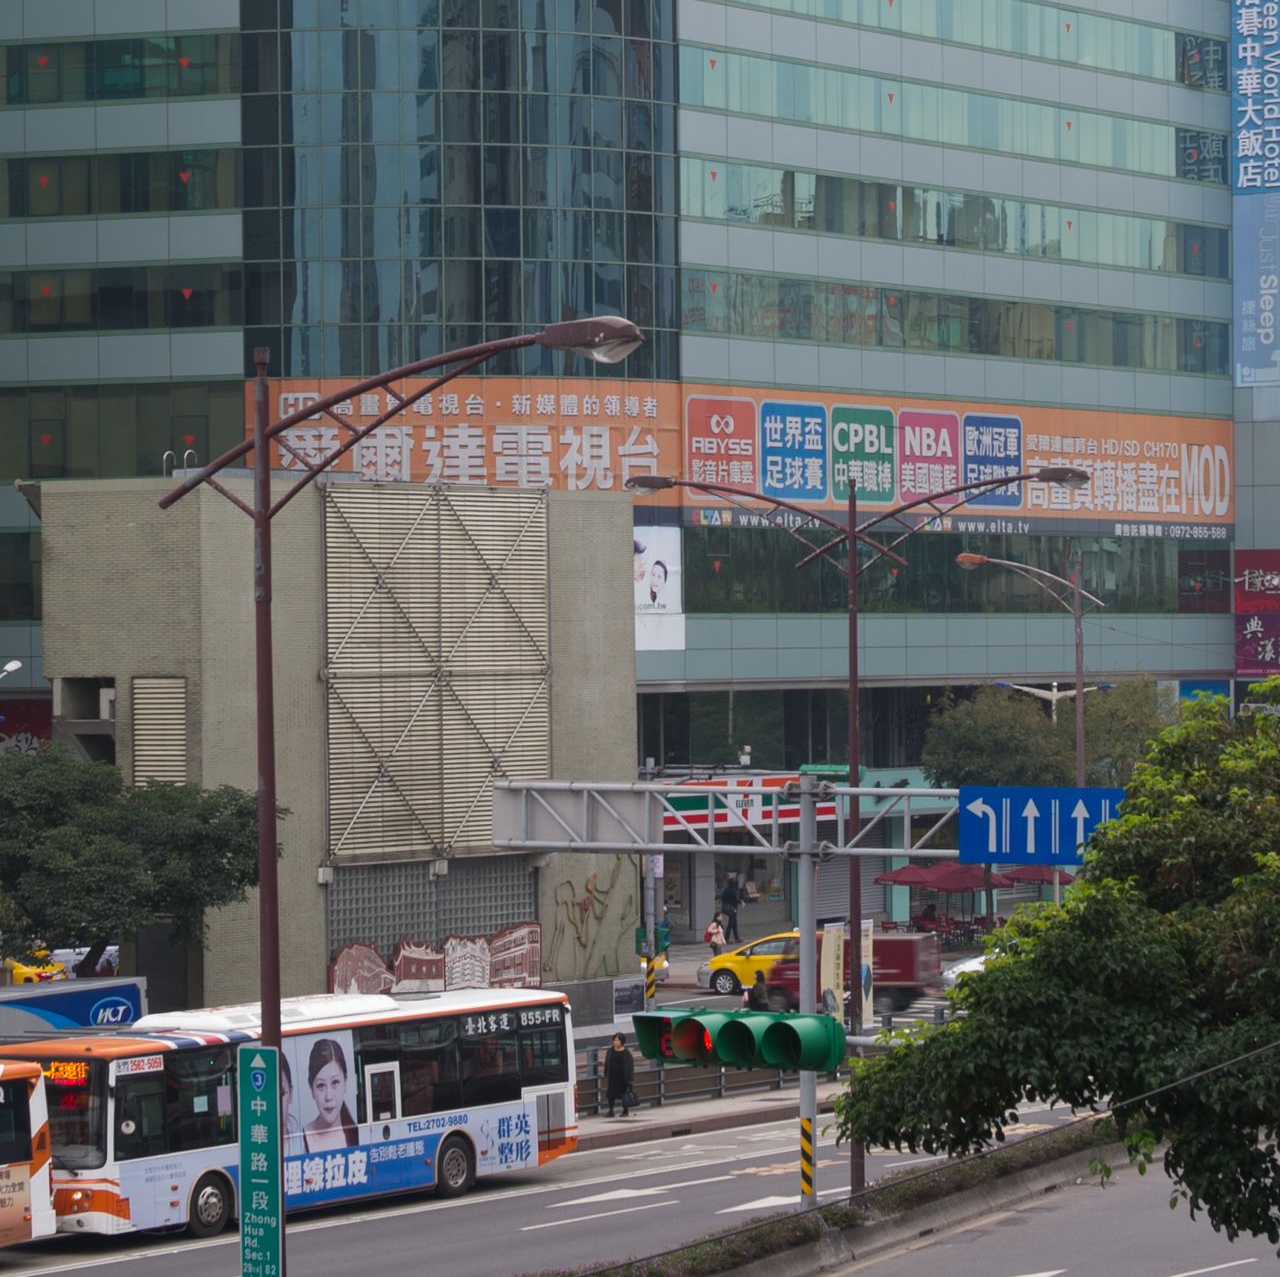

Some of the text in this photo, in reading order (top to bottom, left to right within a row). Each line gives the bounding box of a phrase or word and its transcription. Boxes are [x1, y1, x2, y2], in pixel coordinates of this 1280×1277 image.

[1257, 227, 1278, 345] Just Sleep
[692, 436, 753, 456] ABYSS
[764, 415, 824, 451] 世界盃
[833, 422, 893, 455] CPBL
[904, 425, 953, 458] NBA
[965, 425, 1019, 459] 歐洲冠軍
[1143, 441, 1179, 459] CH170
[765, 455, 824, 491] 足球賽
[834, 458, 892, 493] 中華職棒
[1180, 442, 1231, 517] MOD
[958, 521, 1030, 534] www.elta.tv
[521, 1009, 561, 1026] 855-FR
[254, 1073, 262, 1088] 3
[407, 1114, 469, 1133] TEL:2702-9880
[497, 1113, 531, 1139] 群英
[250, 1095, 270, 1211] 中華路一段
[497, 1138, 531, 1164] 整形
[244, 1212, 277, 1228] Zhong
[244, 1224, 265, 1237] Hua
[244, 1236, 260, 1249] Rd.
[244, 1249, 271, 1262] Sec.1
